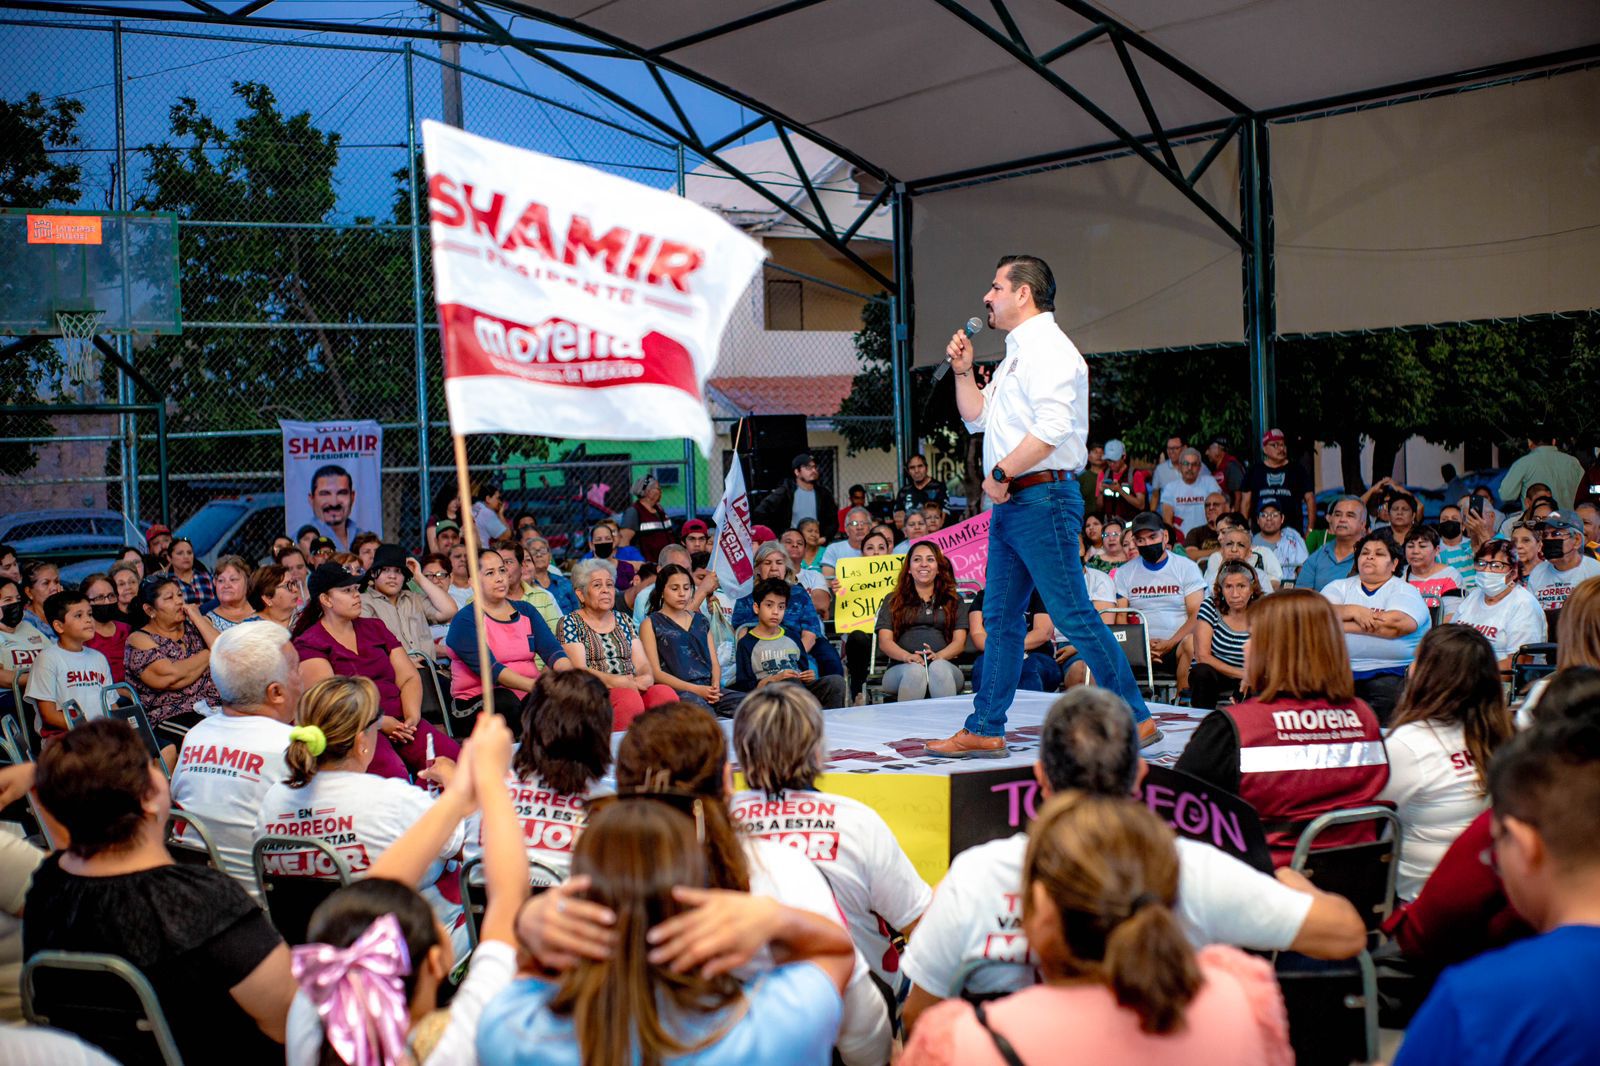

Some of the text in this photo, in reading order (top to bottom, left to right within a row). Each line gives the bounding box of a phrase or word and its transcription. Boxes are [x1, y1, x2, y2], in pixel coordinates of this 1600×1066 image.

[428, 172, 703, 293] SHAMIR
[288, 434, 377, 454] SHAMIR
[310, 452, 359, 460] PRESIDENTE
[1272, 709, 1363, 730] morena
[182, 745, 264, 775] SHAMIR
[189, 766, 238, 777] PRESIDENTE
[298, 808, 312, 818] EN
[769, 820, 780, 829] A
[785, 819, 835, 829] ESTAR
